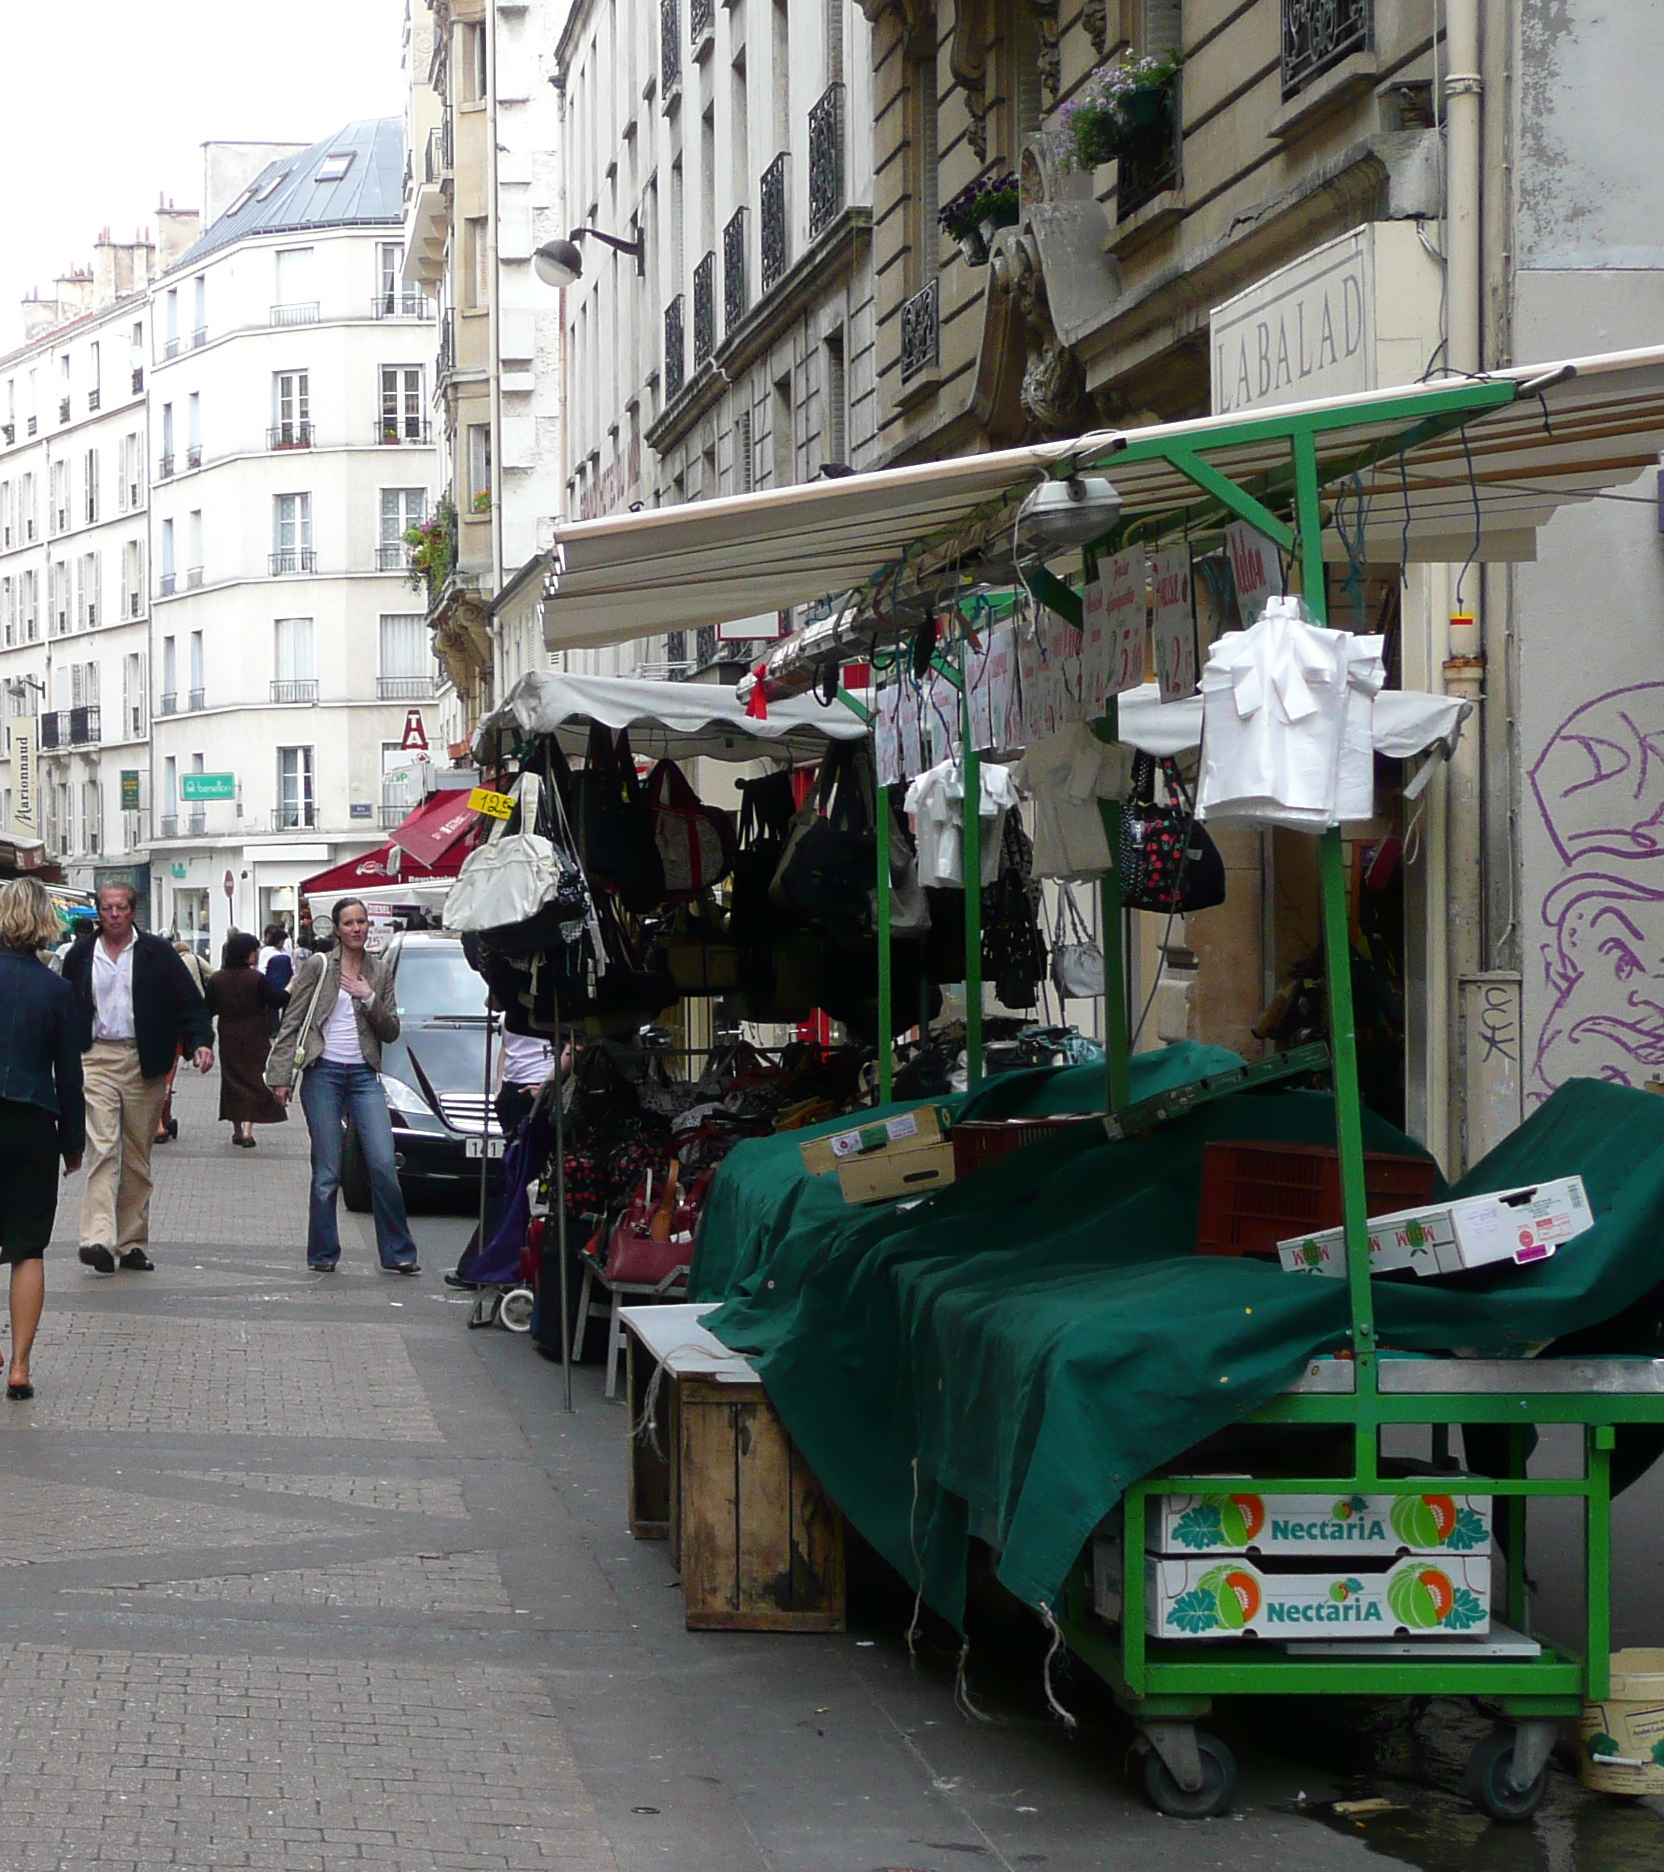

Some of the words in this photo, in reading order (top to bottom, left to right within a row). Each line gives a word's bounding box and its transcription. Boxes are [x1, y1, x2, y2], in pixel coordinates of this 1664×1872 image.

[14, 736, 37, 830] Marionnaud
[1271, 1516, 1386, 1541] NectariA
[1267, 1597, 1383, 1622] NectariA
